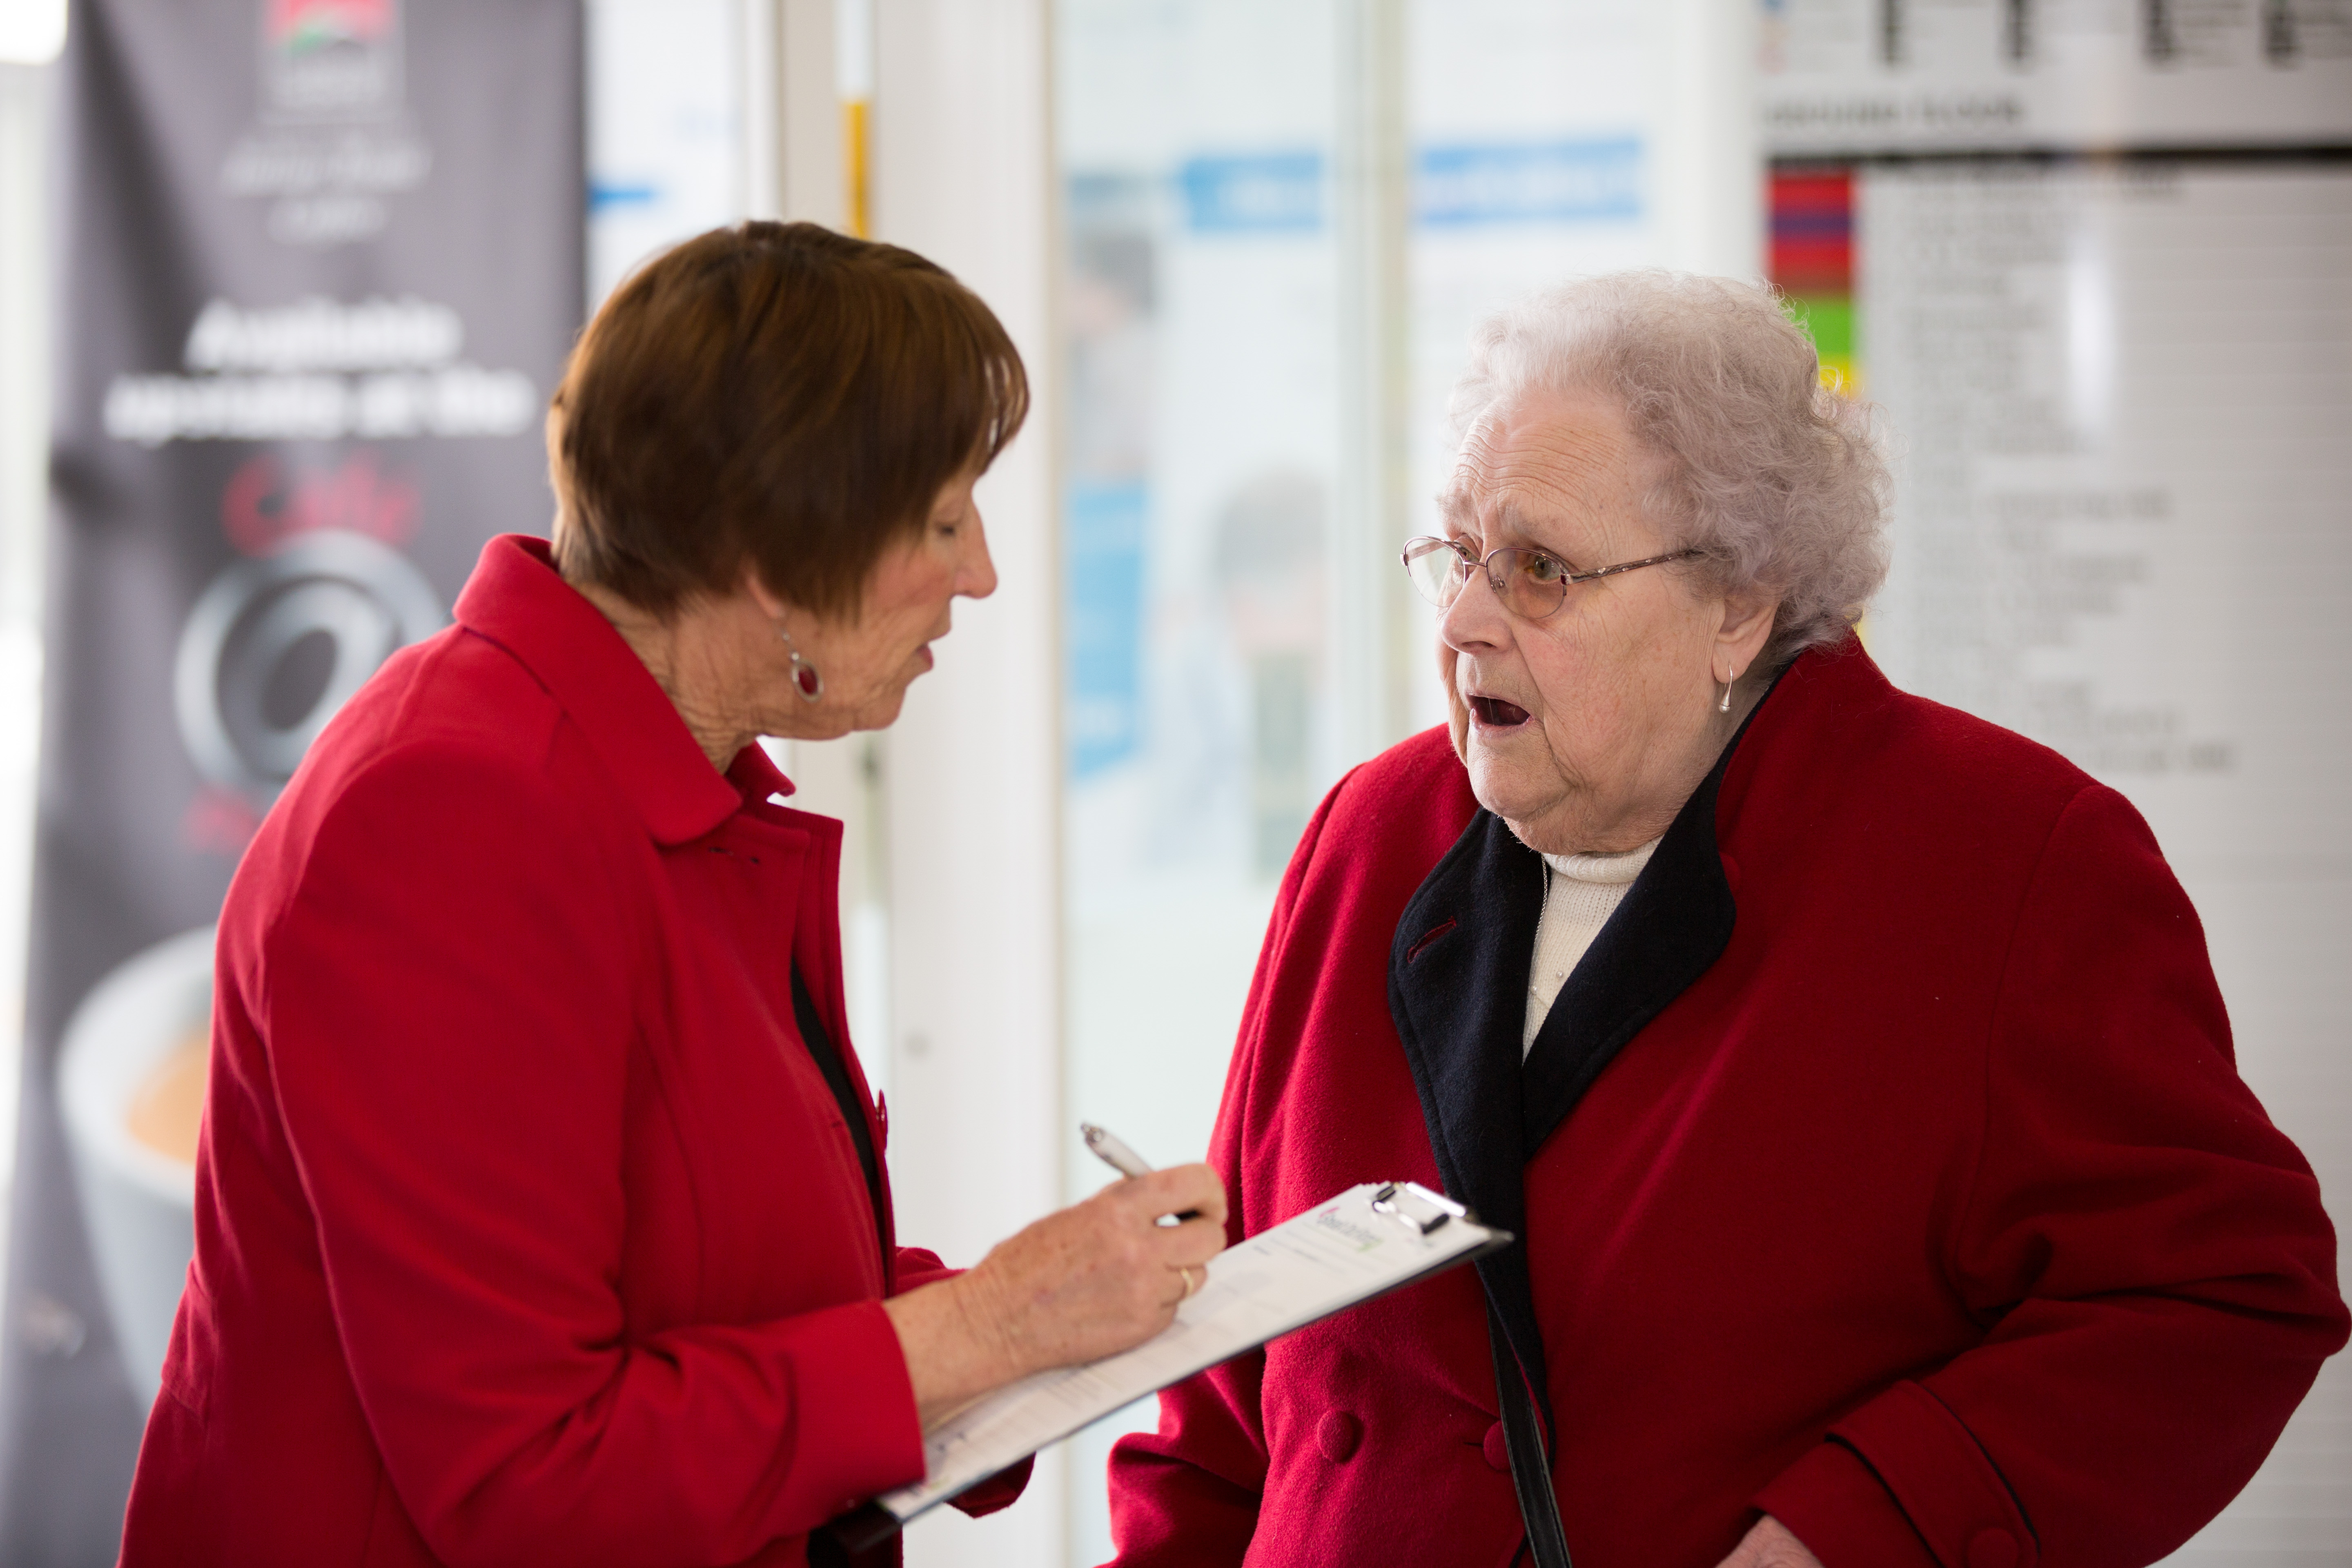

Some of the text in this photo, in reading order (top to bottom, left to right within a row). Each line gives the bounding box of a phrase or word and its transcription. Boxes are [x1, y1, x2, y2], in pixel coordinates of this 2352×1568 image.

[187, 299, 463, 371] Available
[103, 361, 537, 448] upstairs at the
